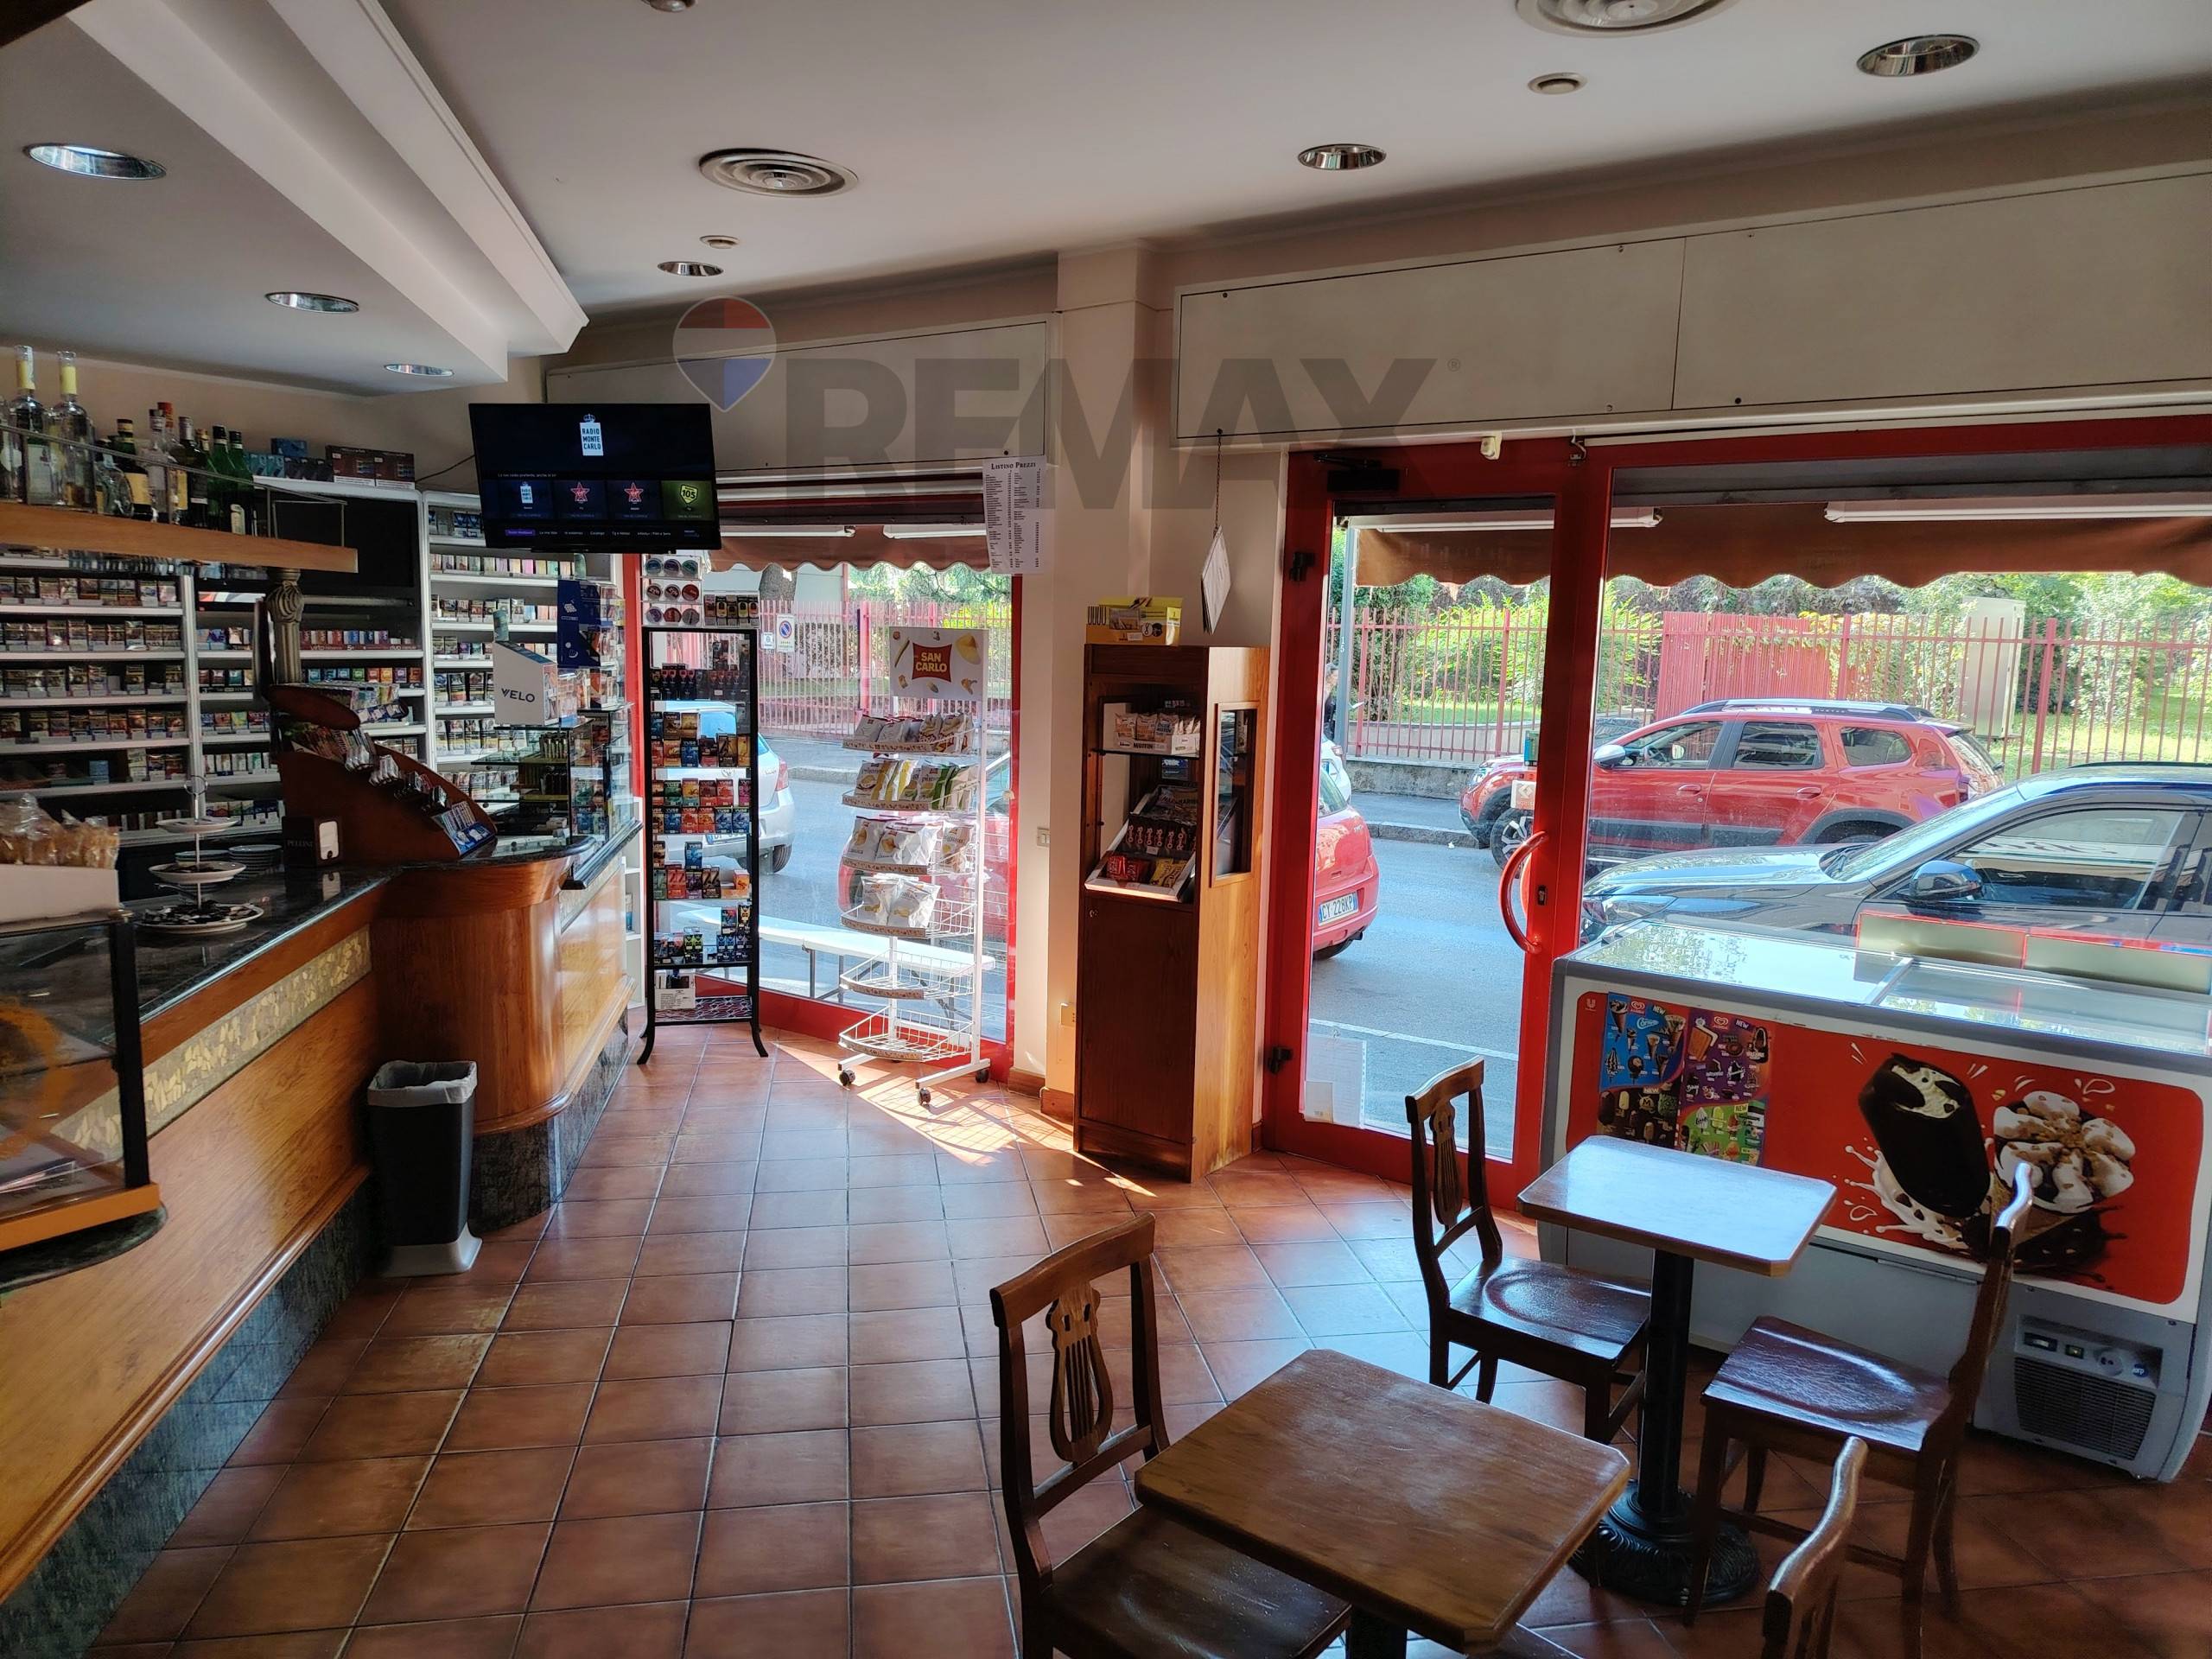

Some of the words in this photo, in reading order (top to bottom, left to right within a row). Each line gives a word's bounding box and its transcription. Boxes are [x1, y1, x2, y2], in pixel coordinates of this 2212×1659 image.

[682, 490, 696, 499] 105
[921, 652, 941, 662] SAN
[916, 662, 948, 672] CARLO
[501, 688, 535, 702] VELO
[1322, 903, 1331, 919] CY
[1653, 1005, 1667, 1014] NEW
[1735, 1020, 1749, 1029] NEW
